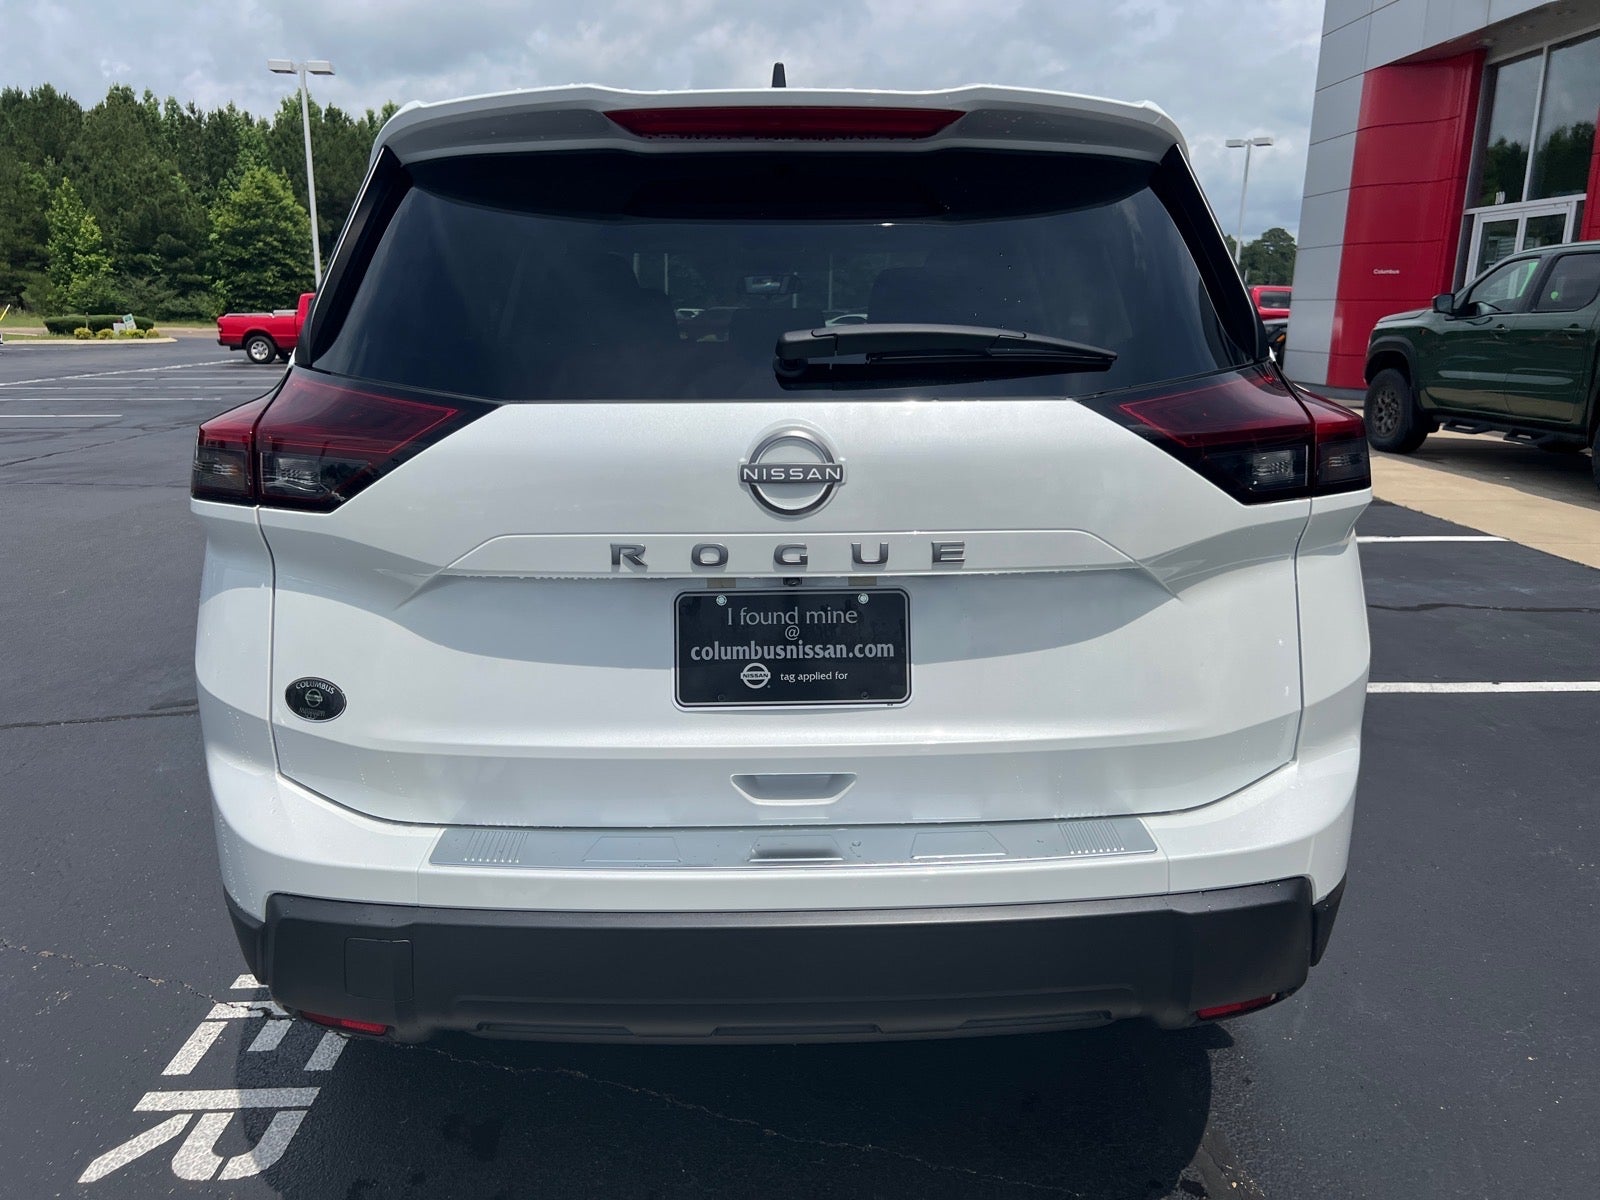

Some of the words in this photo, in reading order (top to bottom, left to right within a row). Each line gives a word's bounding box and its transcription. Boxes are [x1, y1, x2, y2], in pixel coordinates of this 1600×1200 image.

[742, 466, 843, 481] NISSAN
[609, 541, 966, 567] ROGUE
[727, 607, 733, 626] I
[740, 606, 799, 626] found
[806, 606, 858, 624] mine
[784, 625, 800, 641] @
[690, 640, 895, 661] columbusnissan.com
[780, 673, 796, 683] tag
[797, 671, 832, 683] applied
[835, 671, 849, 681] for
[295, 680, 336, 695] COLUMBUS
